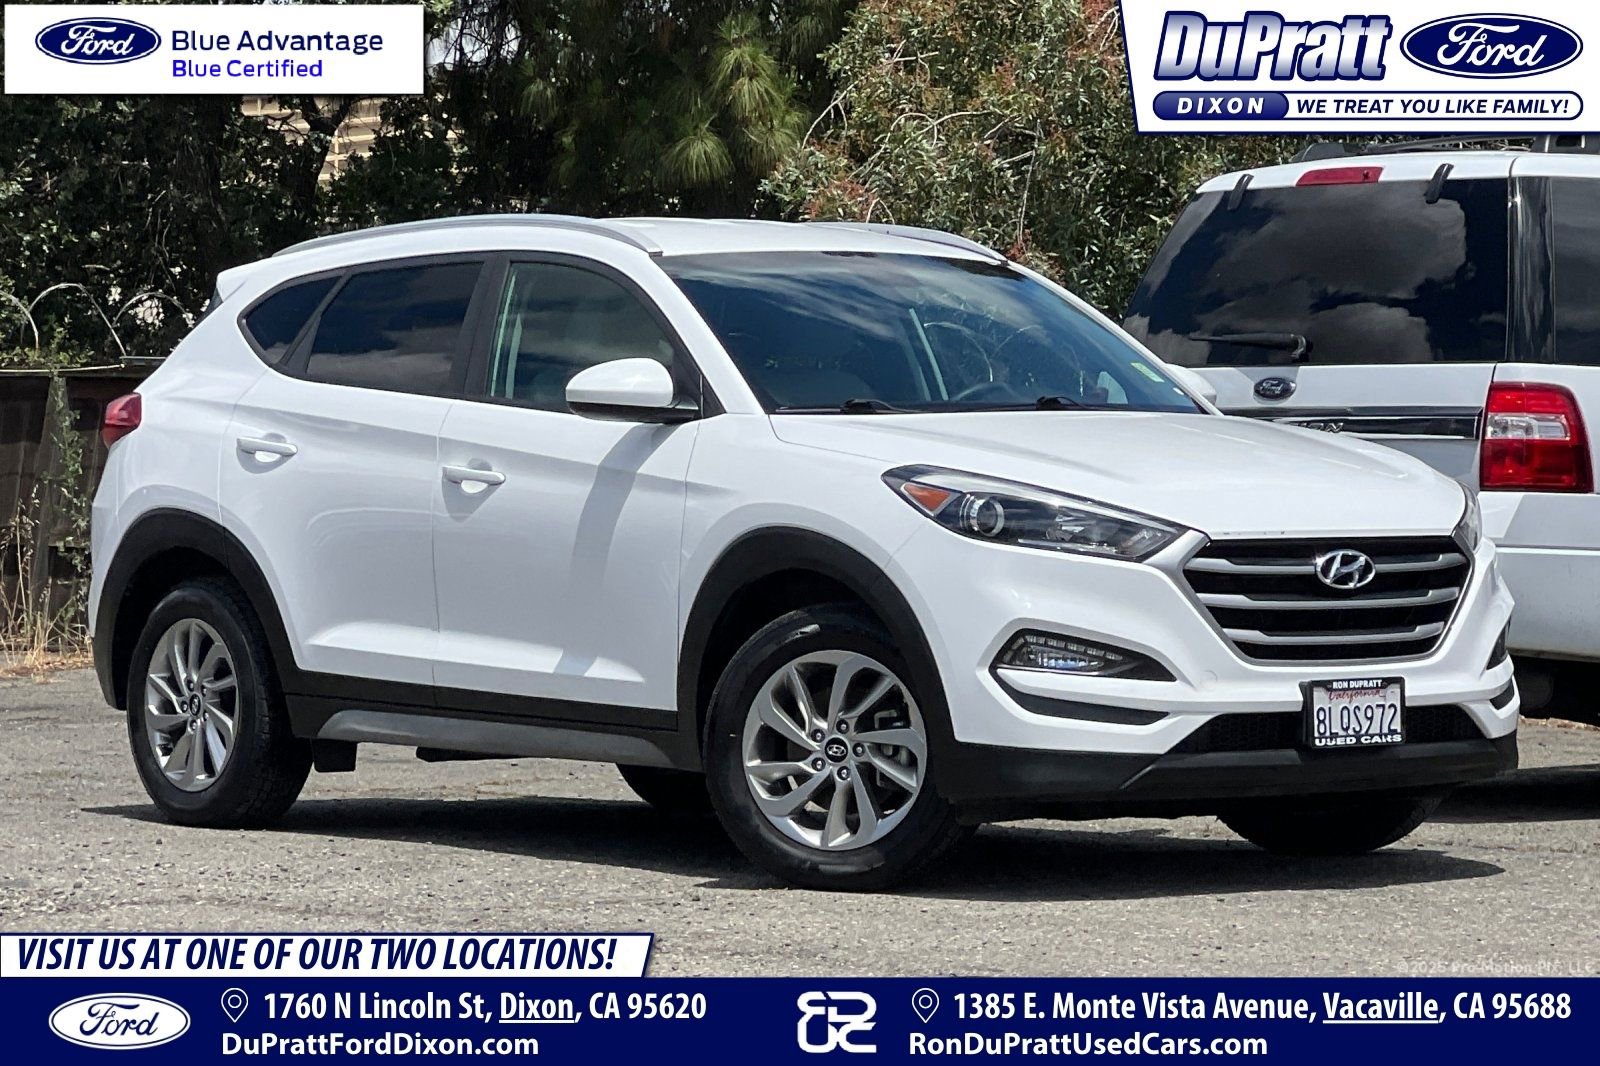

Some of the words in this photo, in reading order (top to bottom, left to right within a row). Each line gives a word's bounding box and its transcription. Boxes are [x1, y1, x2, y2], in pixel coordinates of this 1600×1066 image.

[1333, 681, 1348, 689] RON
[1349, 680, 1382, 688] DUPRATT
[1316, 703, 1398, 736] 8LQS972
[1315, 736, 1357, 746] USED
[1360, 734, 1402, 744] CARS
